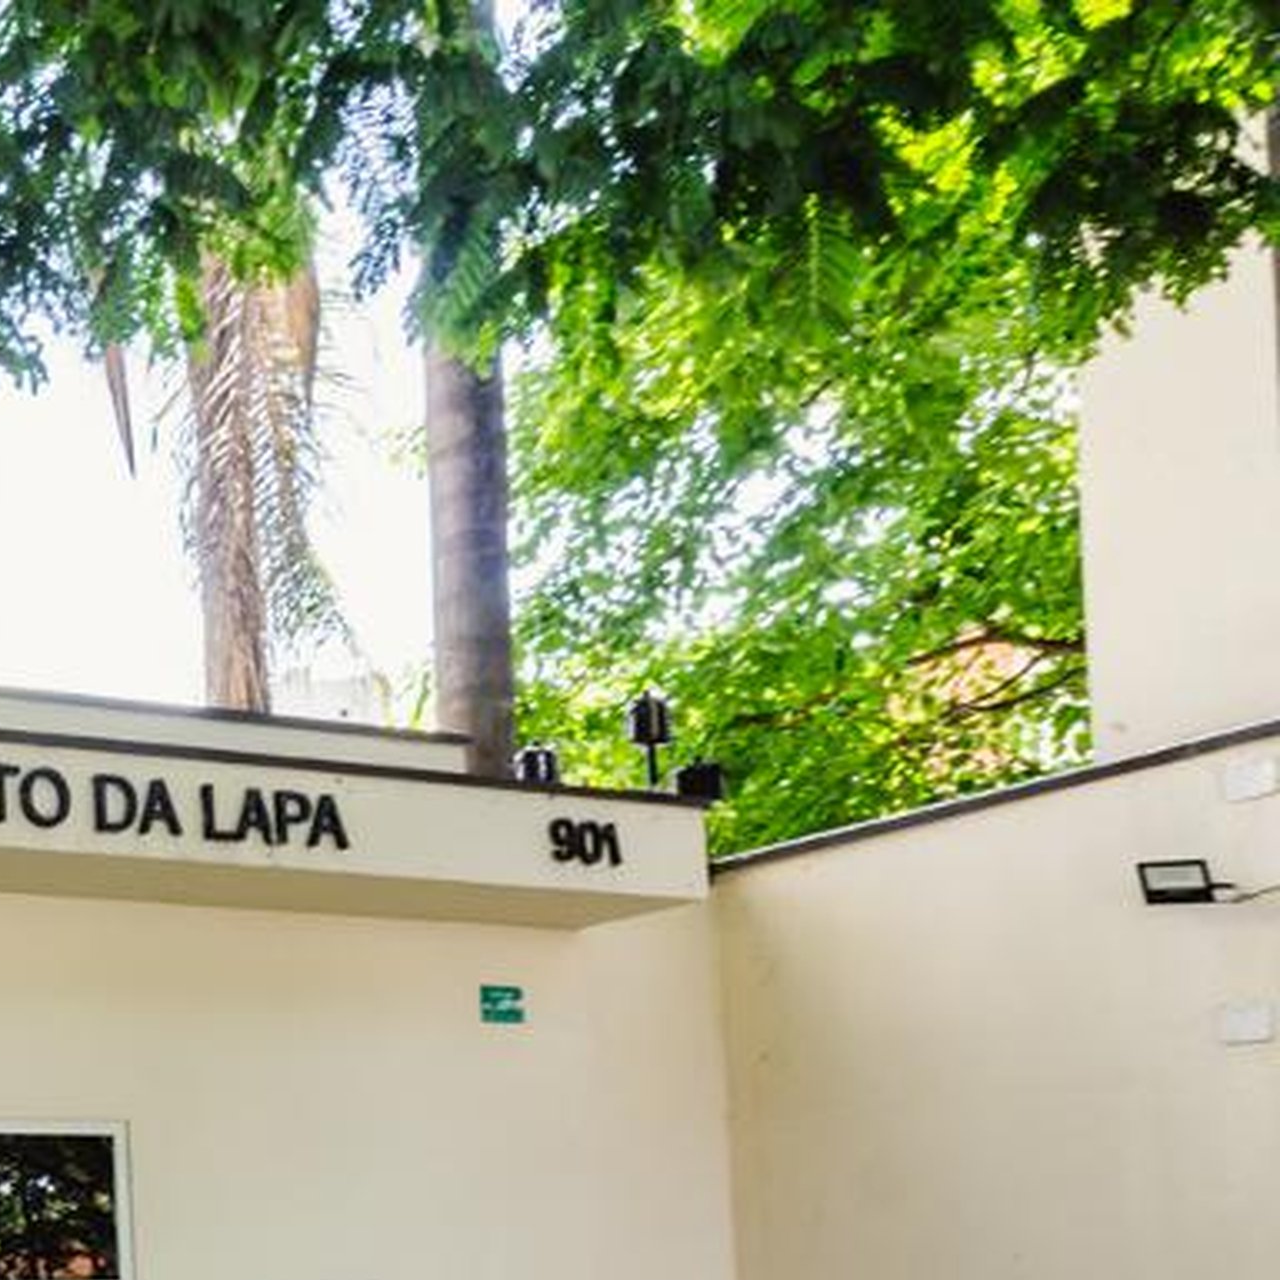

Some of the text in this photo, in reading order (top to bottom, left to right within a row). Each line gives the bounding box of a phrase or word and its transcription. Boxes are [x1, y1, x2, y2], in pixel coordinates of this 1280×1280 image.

[92, 773, 182, 838] DA
[200, 783, 350, 851] LAPA
[548, 817, 622, 867] 901
